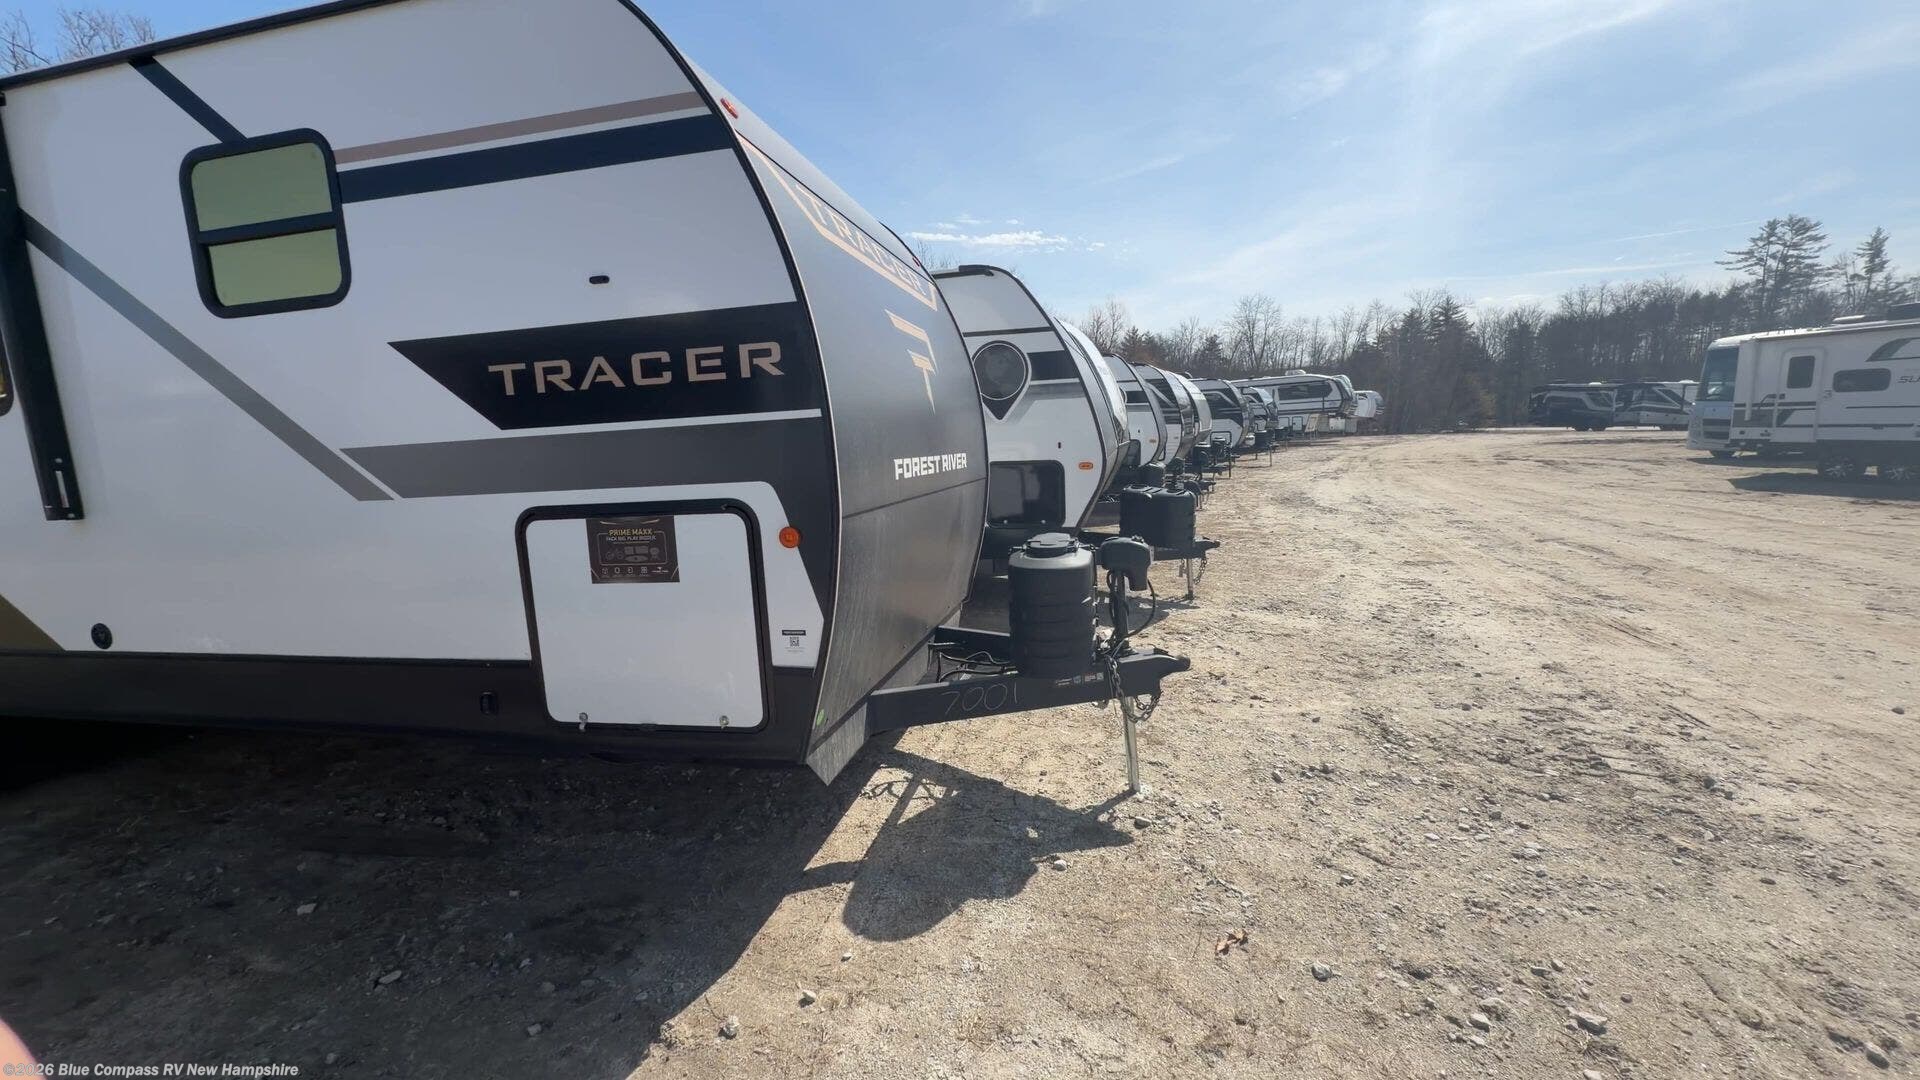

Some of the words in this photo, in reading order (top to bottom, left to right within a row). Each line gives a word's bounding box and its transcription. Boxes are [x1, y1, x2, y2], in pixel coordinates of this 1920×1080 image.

[796, 184, 927, 296] TRACER
[488, 341, 785, 396] TRACER
[893, 455, 941, 481] FOREST
[941, 452, 968, 473] RIVER
[609, 529, 631, 537] PRIME
[632, 527, 653, 536] MAXX
[941, 681, 1018, 715] 7001
